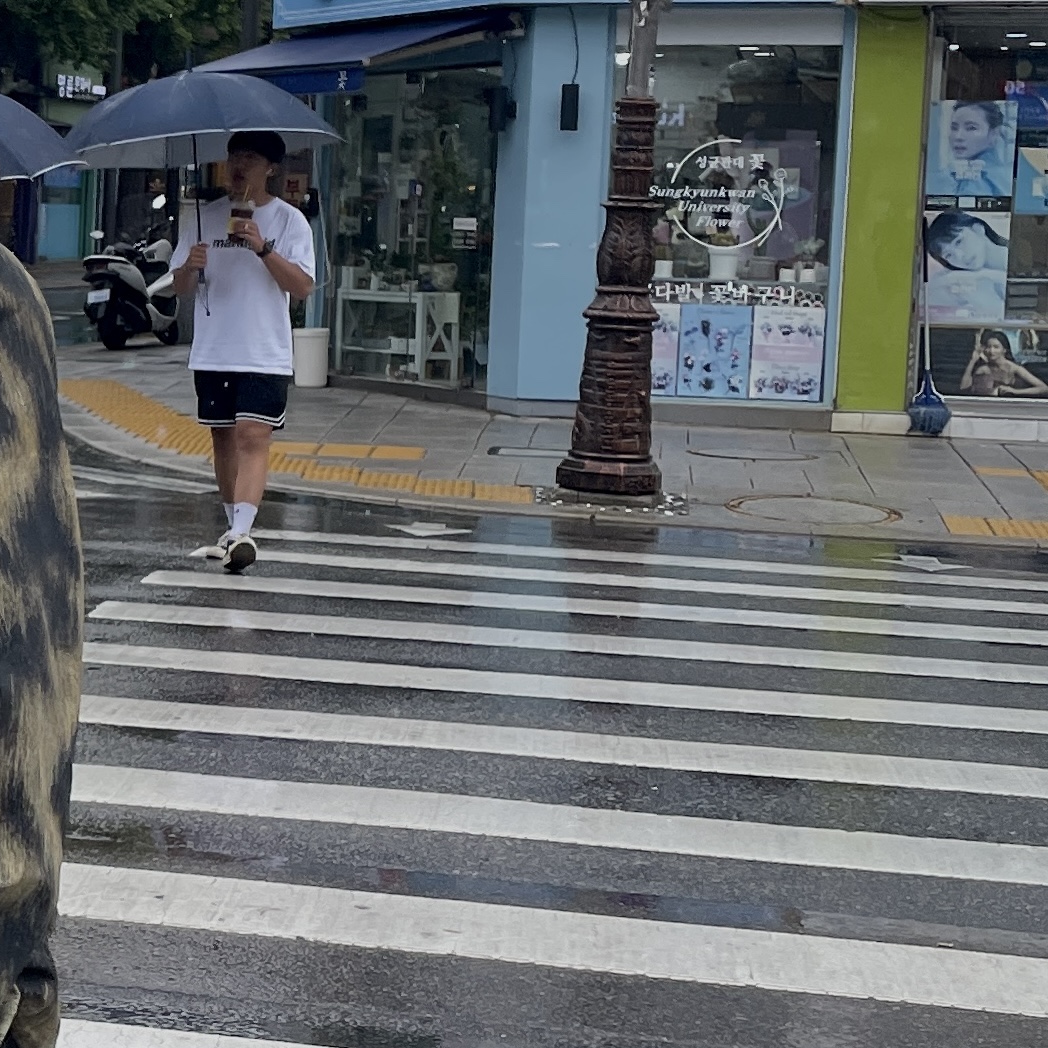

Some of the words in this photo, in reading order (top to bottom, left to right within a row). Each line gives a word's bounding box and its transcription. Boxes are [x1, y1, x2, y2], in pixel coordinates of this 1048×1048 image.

[748, 153, 767, 170] 꽃
[647, 185, 756, 200] Sungkyunkwan
[677, 200, 751, 214] University
[695, 214, 744, 228] Flower
